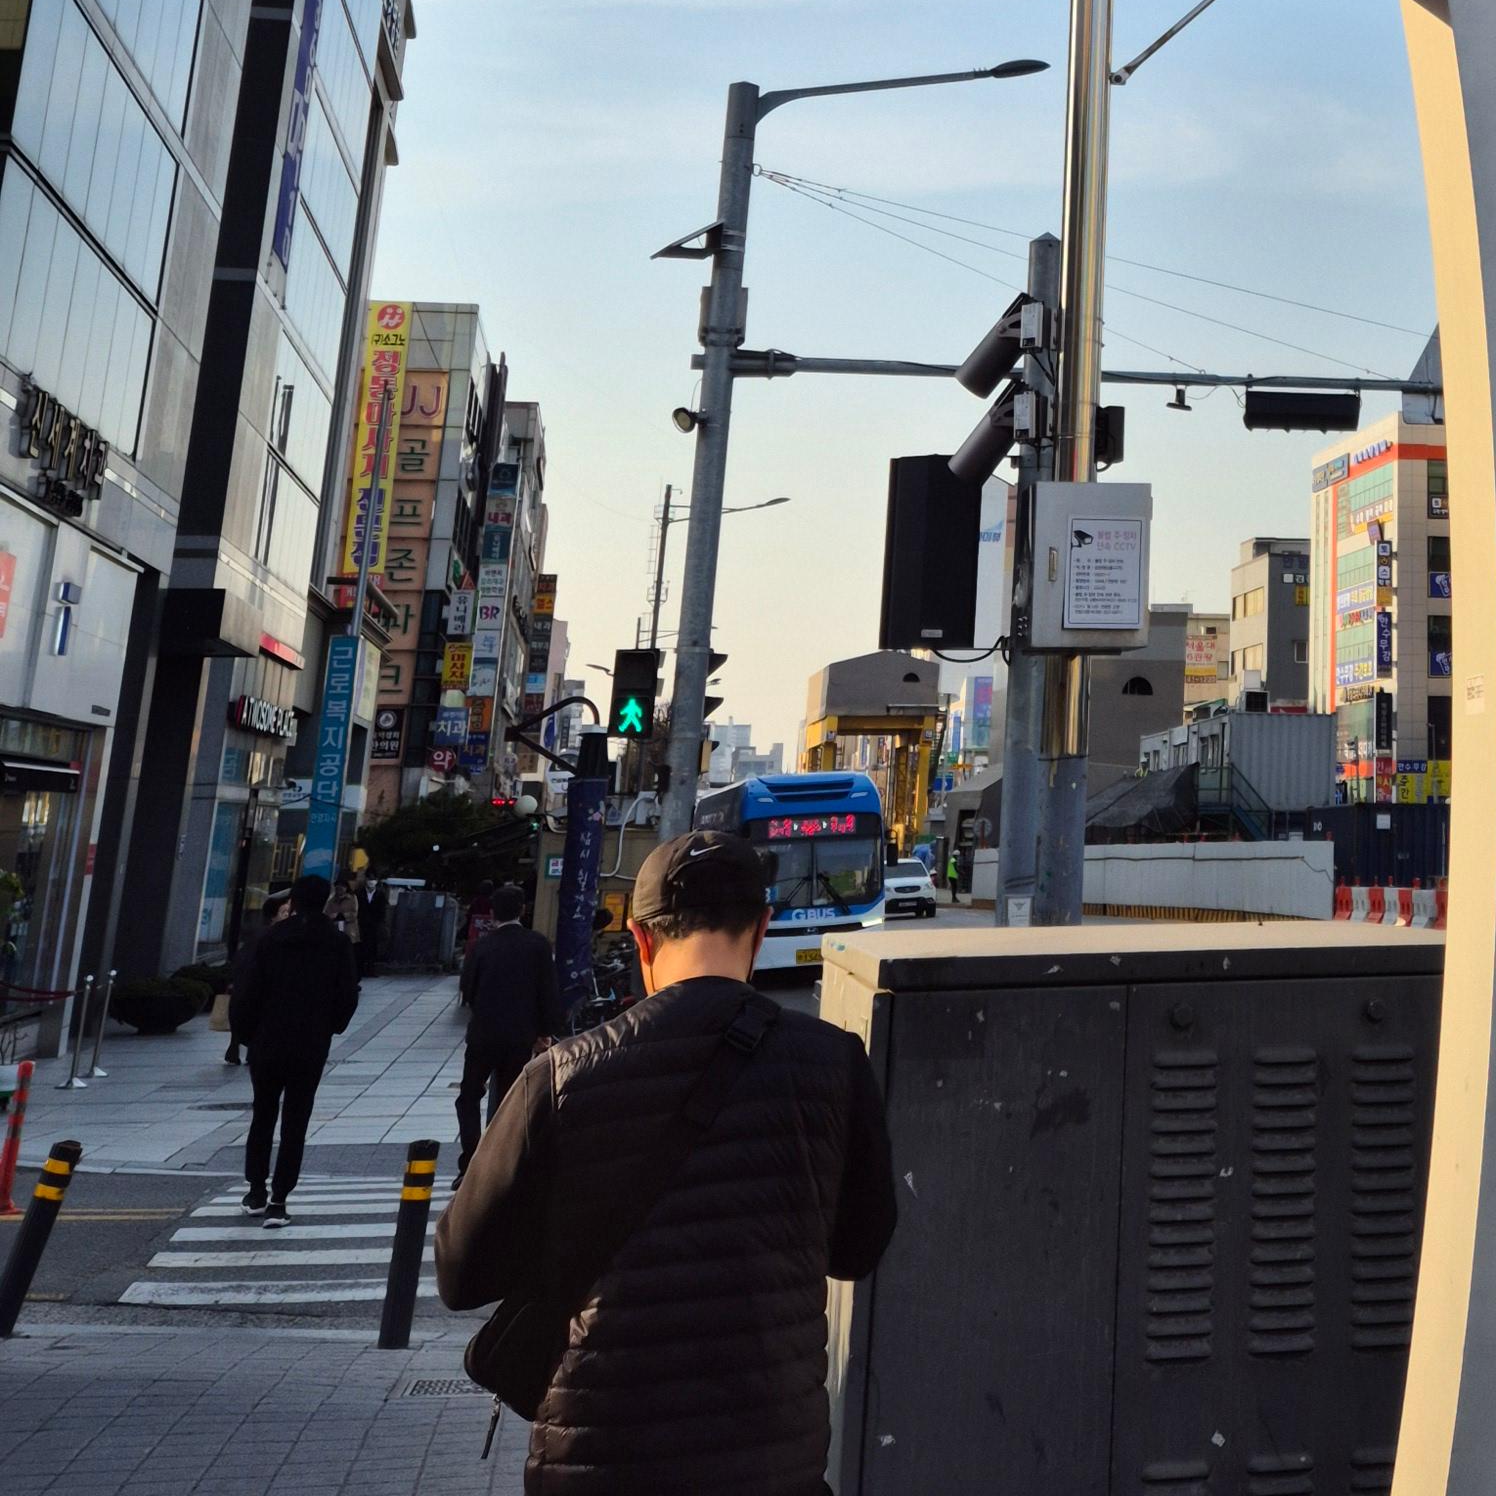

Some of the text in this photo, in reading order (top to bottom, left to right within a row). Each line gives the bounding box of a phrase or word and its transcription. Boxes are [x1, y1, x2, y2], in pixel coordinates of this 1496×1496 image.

[1113, 542, 1137, 551] CCTV
[316, 645, 354, 804] 근로복지공단
[438, 719, 466, 737] 치과
